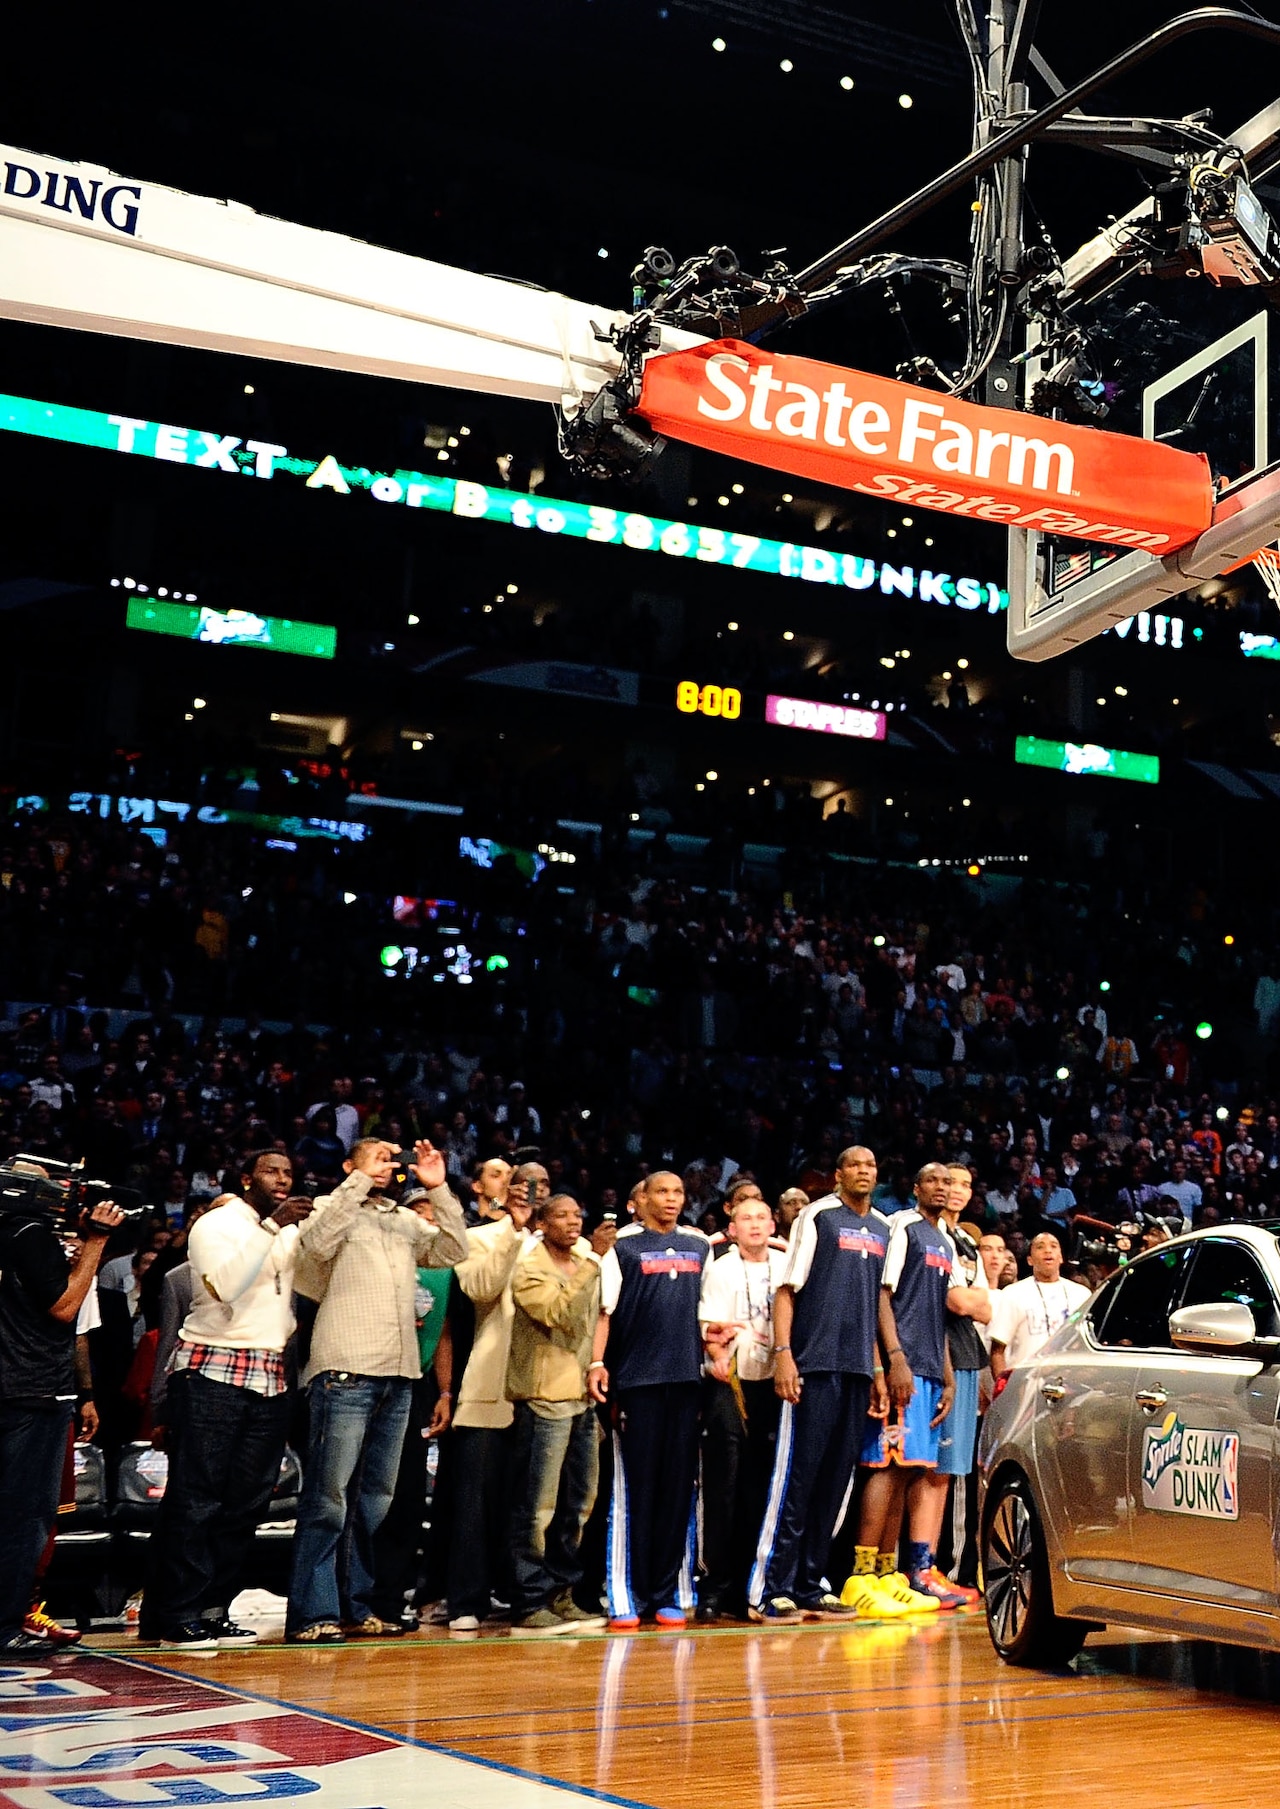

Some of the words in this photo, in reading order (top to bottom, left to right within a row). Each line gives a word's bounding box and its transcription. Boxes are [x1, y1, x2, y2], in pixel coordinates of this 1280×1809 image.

[698, 353, 890, 456] State
[897, 397, 1077, 495] Farm
[107, 414, 287, 479] TEXT
[306, 454, 351, 494] A
[370, 477, 432, 507] or
[452, 481, 489, 518] B
[510, 498, 567, 534] to
[586, 506, 761, 567] 38657
[778, 542, 1000, 614] (DUNKS)
[854, 474, 1014, 524] State
[1011, 507, 1171, 548] Farm
[676, 681, 742, 719] 8:00
[776, 698, 878, 739] STAPLES
[1186, 1435, 1220, 1468] SLAM
[1173, 1469, 1221, 1512] DUNK
